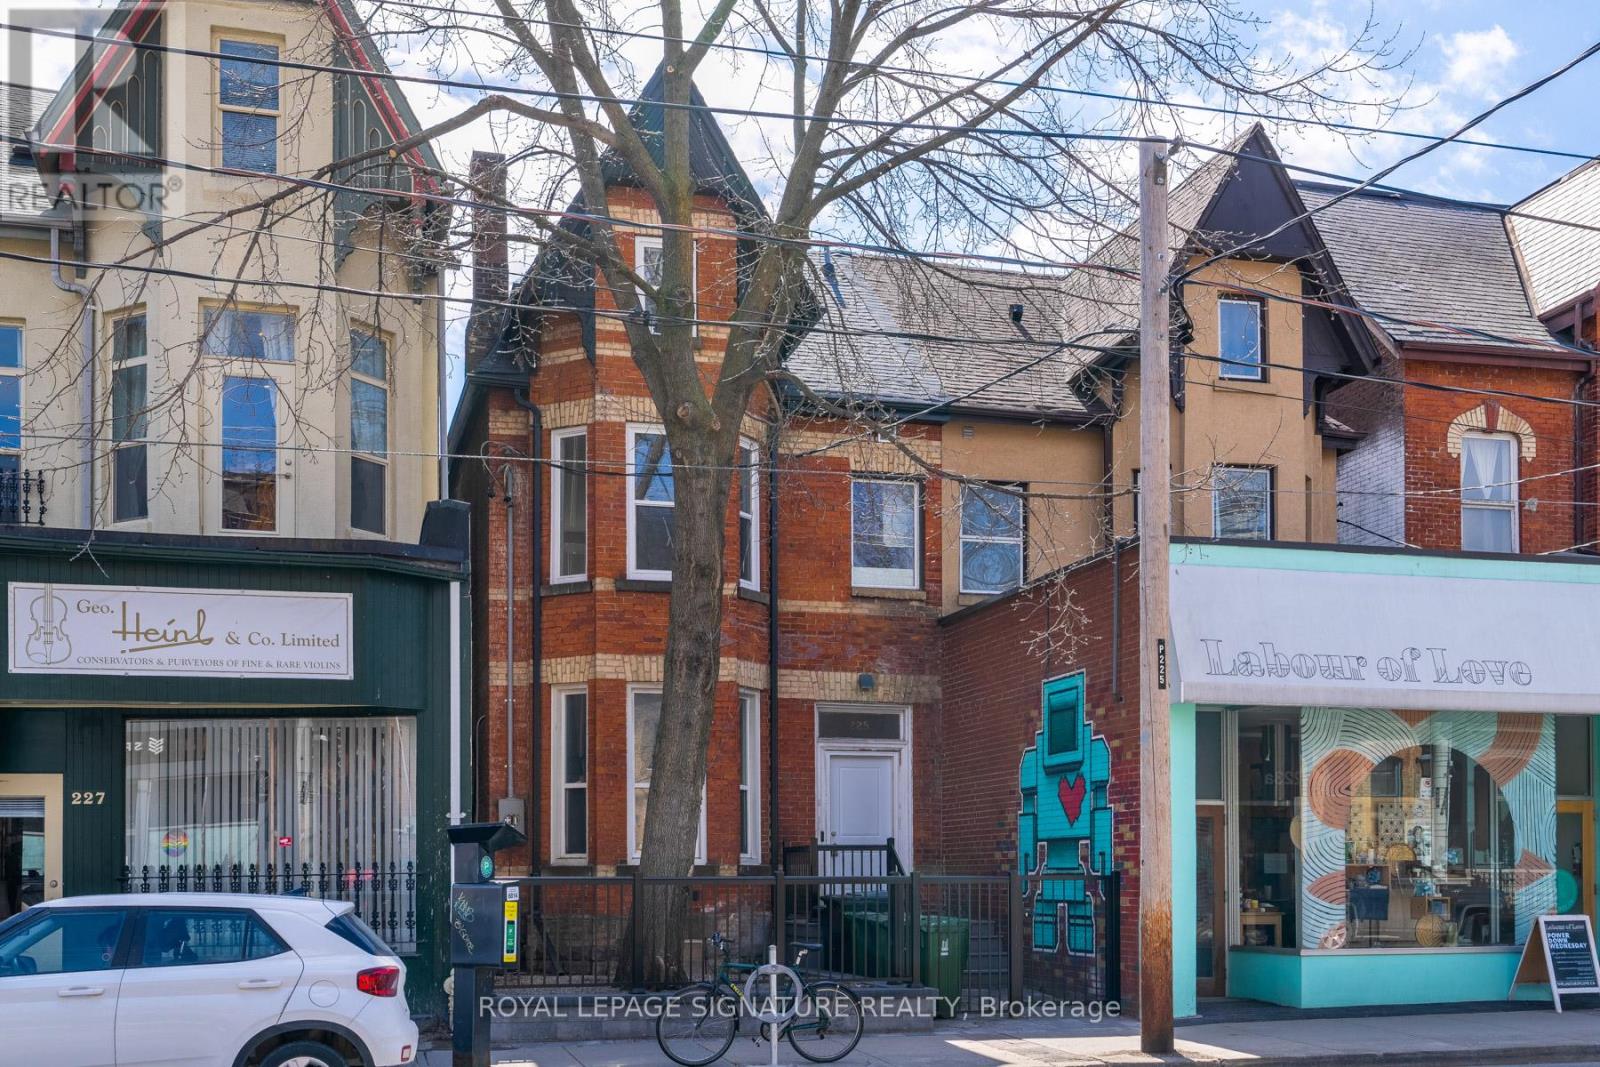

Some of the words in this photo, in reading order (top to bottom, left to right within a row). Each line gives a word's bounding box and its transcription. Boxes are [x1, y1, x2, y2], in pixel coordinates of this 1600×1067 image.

[76, 599, 114, 614] Geo.
[112, 601, 214, 645] Heinl
[225, 631, 240, 645] &
[248, 632, 275, 646] Co.
[281, 633, 340, 647] Limited
[77, 656, 153, 665] CONSERVATORS
[156, 657, 164, 666] &
[168, 658, 224, 667] PURVEYORS
[226, 659, 239, 667] OF
[242, 660, 261, 668] FINE
[265, 660, 273, 668] &
[276, 660, 301, 669] RARE
[303, 661, 342, 669] VIOLINS
[1200, 638, 1368, 681] Labour
[1376, 647, 1422, 682] of
[1426, 647, 1533, 686] Love
[71, 791, 106, 805] 227
